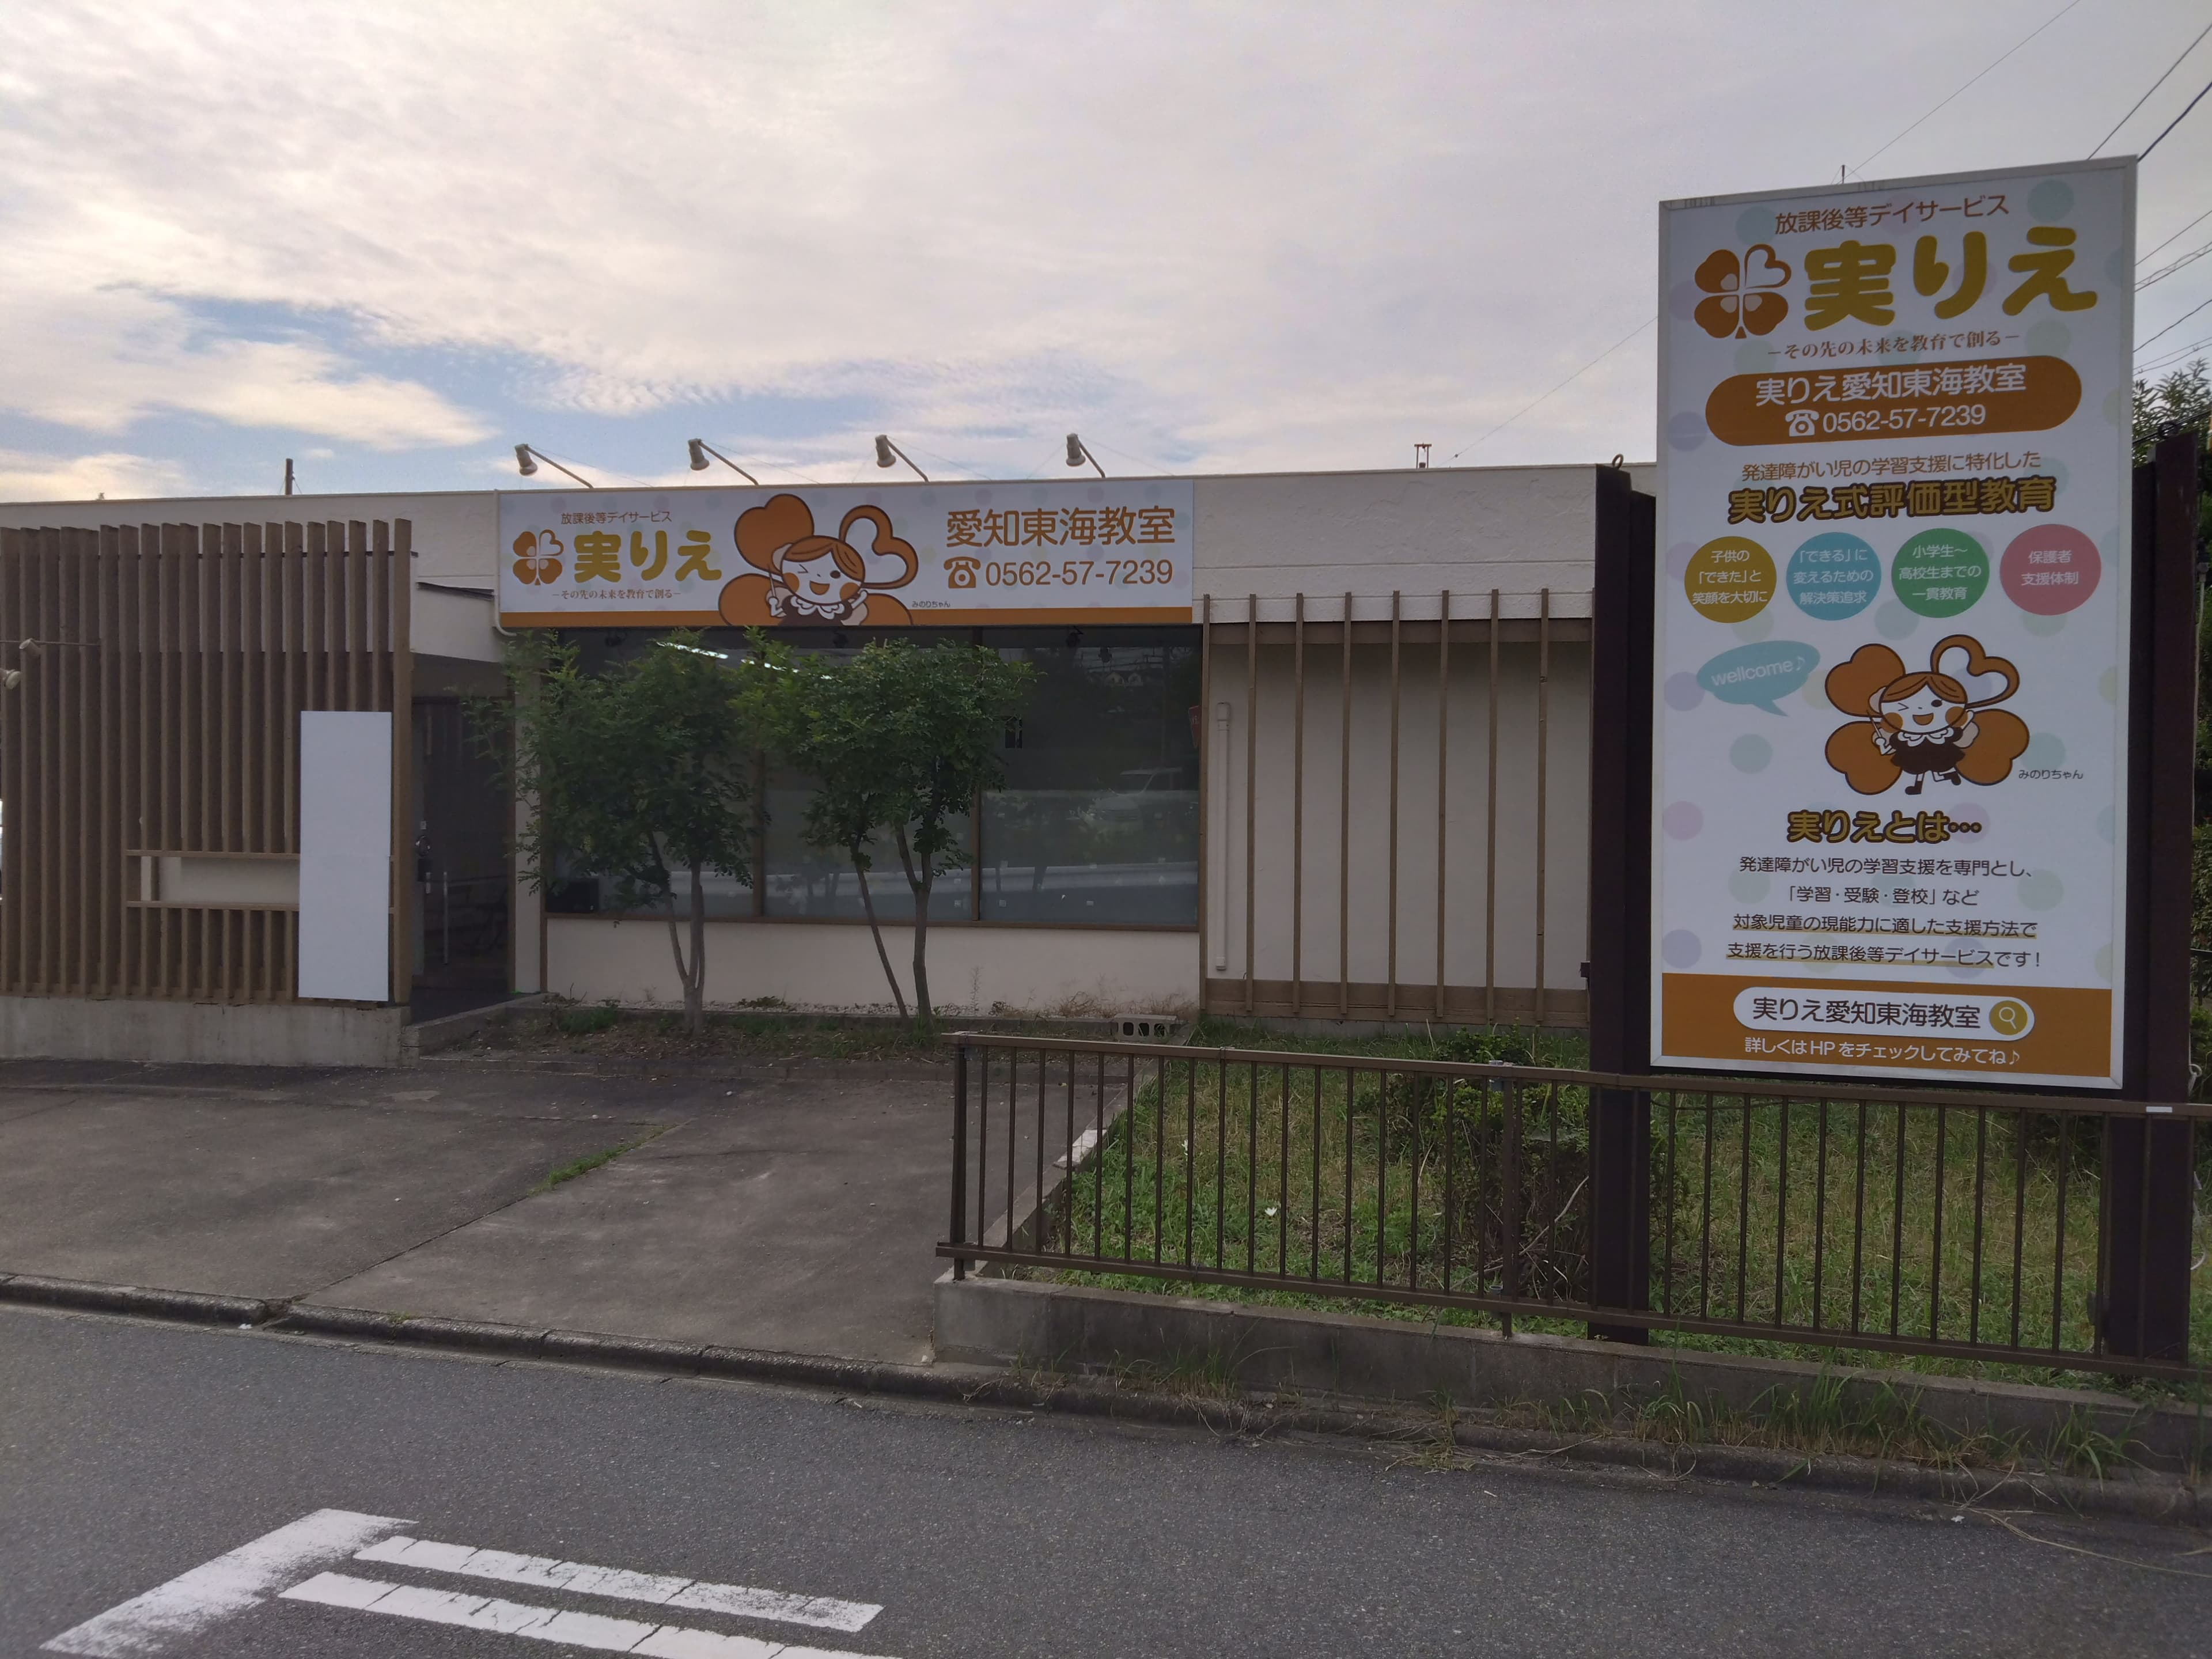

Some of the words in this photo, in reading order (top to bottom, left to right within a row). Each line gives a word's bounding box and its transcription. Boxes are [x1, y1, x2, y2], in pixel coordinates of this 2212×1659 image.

[1775, 194, 2009, 235] 放課後等デイサービス
[1804, 226, 2097, 331] 実りえ
[1755, 363, 2027, 407] 実りえ愛知東海教室
[1823, 404, 1986, 433] 0562-57-7239
[1741, 451, 2041, 482] 発達障がい児の学習支援に特化した
[1728, 476, 2056, 524] 実りえ式評価型教育
[560, 511, 672, 525] 放課後等デイサービス
[946, 506, 1175, 548] 愛知東海教室
[574, 529, 722, 583] 実りえ
[1711, 550, 1749, 563] 子供の
[1800, 549, 1868, 563] 「できる」に
[2028, 550, 2072, 564] 保護者
[986, 559, 1173, 586] 0562-57-7239
[1699, 571, 1761, 584] 「できた」と
[1793, 570, 1873, 585] 変えるための
[1899, 566, 1981, 580] 高校生までの
[2021, 571, 2078, 586] 支援体制
[1692, 590, 1768, 604] 笑顔を大切に
[1800, 590, 1867, 604] 解決策追求
[1912, 587, 1968, 600] 一貫教育
[2018, 770, 2084, 779] みのりちゃん
[1740, 856, 2032, 877] 発達障がい児の学習支援を専門とし、
[1733, 914, 2038, 937] 対象児童の現能力に適した支援方法で
[1752, 996, 1980, 1030] 実りえ愛知東海教室
